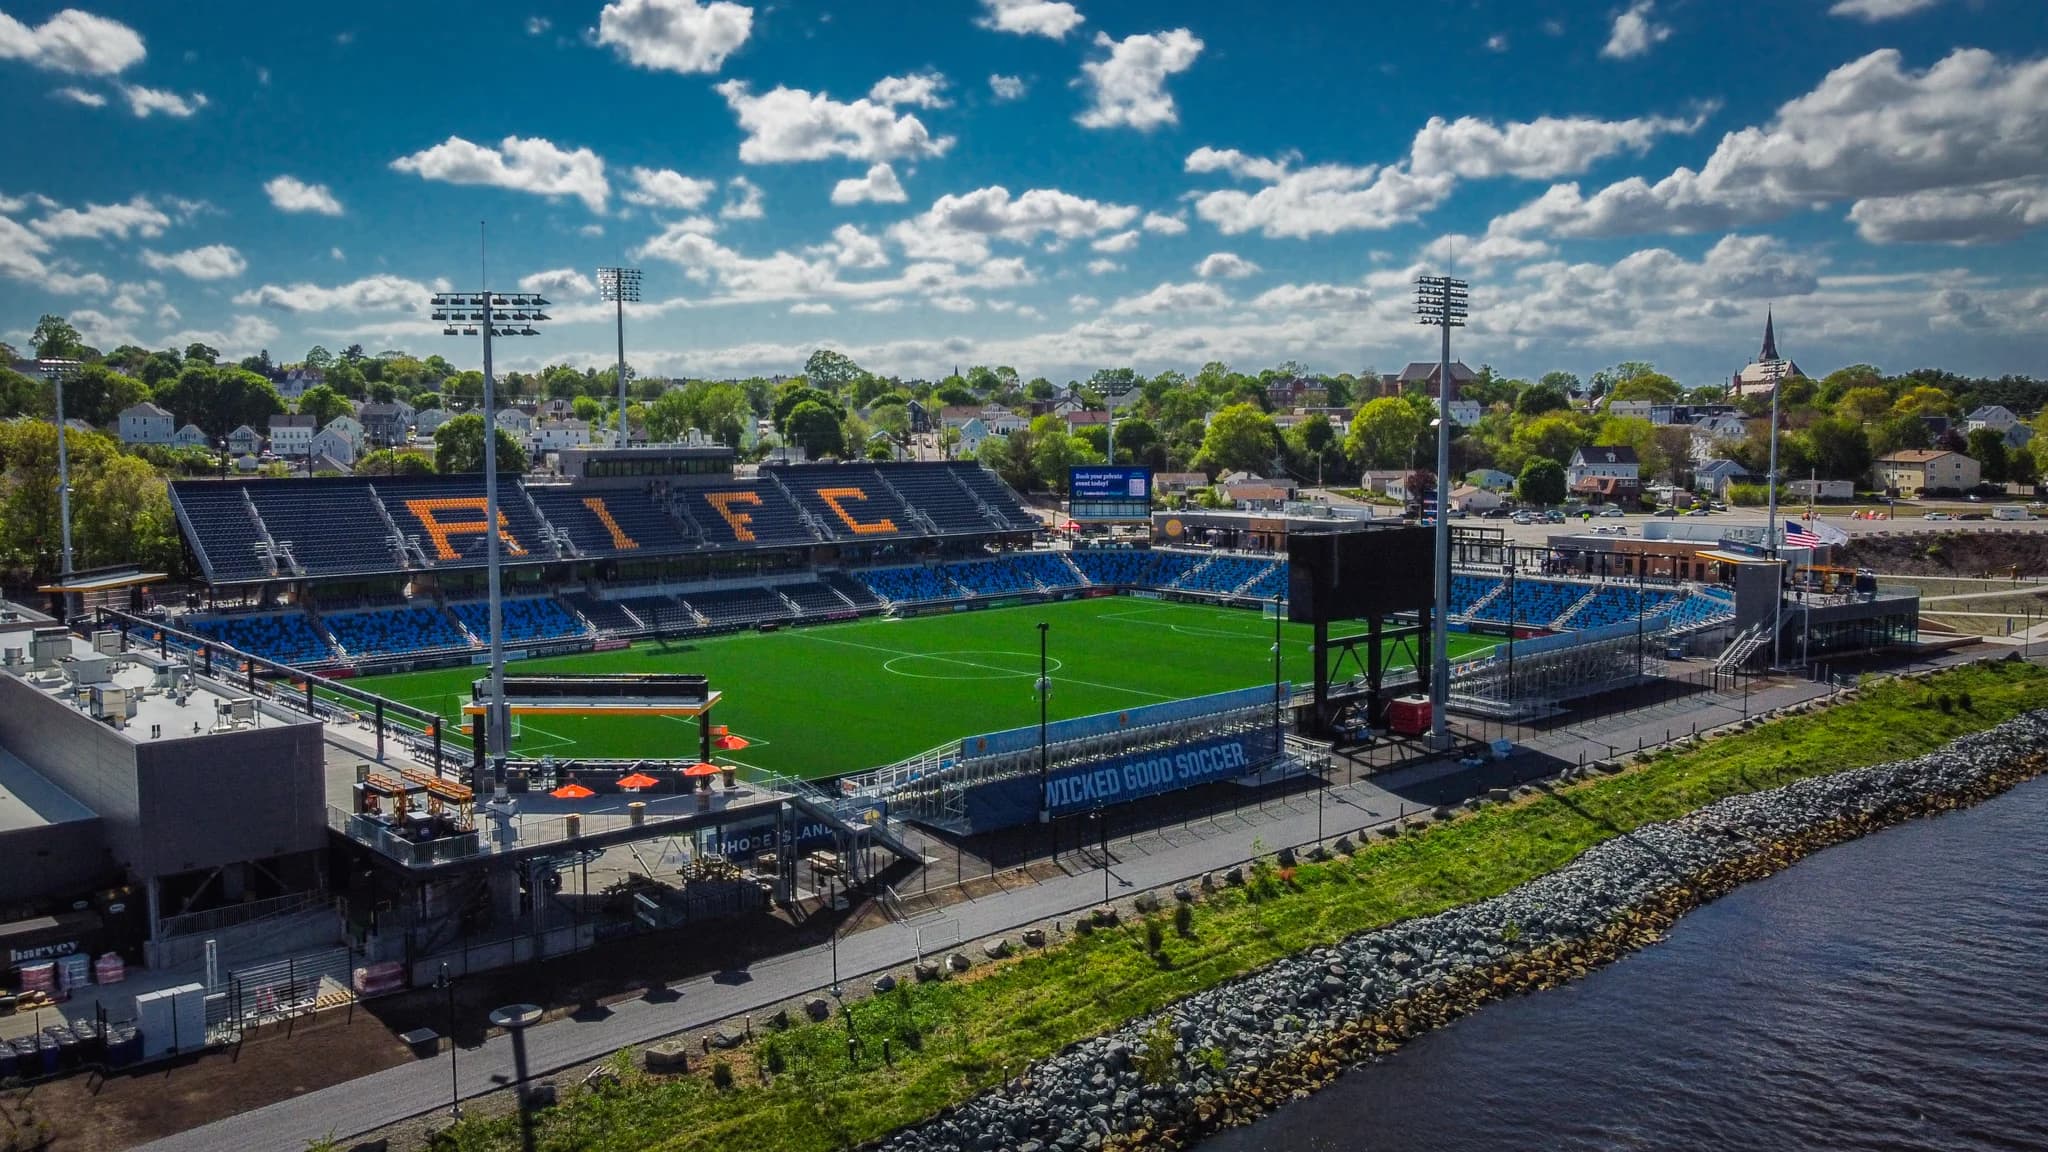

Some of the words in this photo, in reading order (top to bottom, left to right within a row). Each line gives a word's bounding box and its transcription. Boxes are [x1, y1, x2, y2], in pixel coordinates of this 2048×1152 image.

[1040, 769, 1120, 807] WICKED
[1123, 757, 1174, 791] GOOD
[1176, 743, 1249, 778] SOCCER.
[10, 941, 80, 961] harvey
